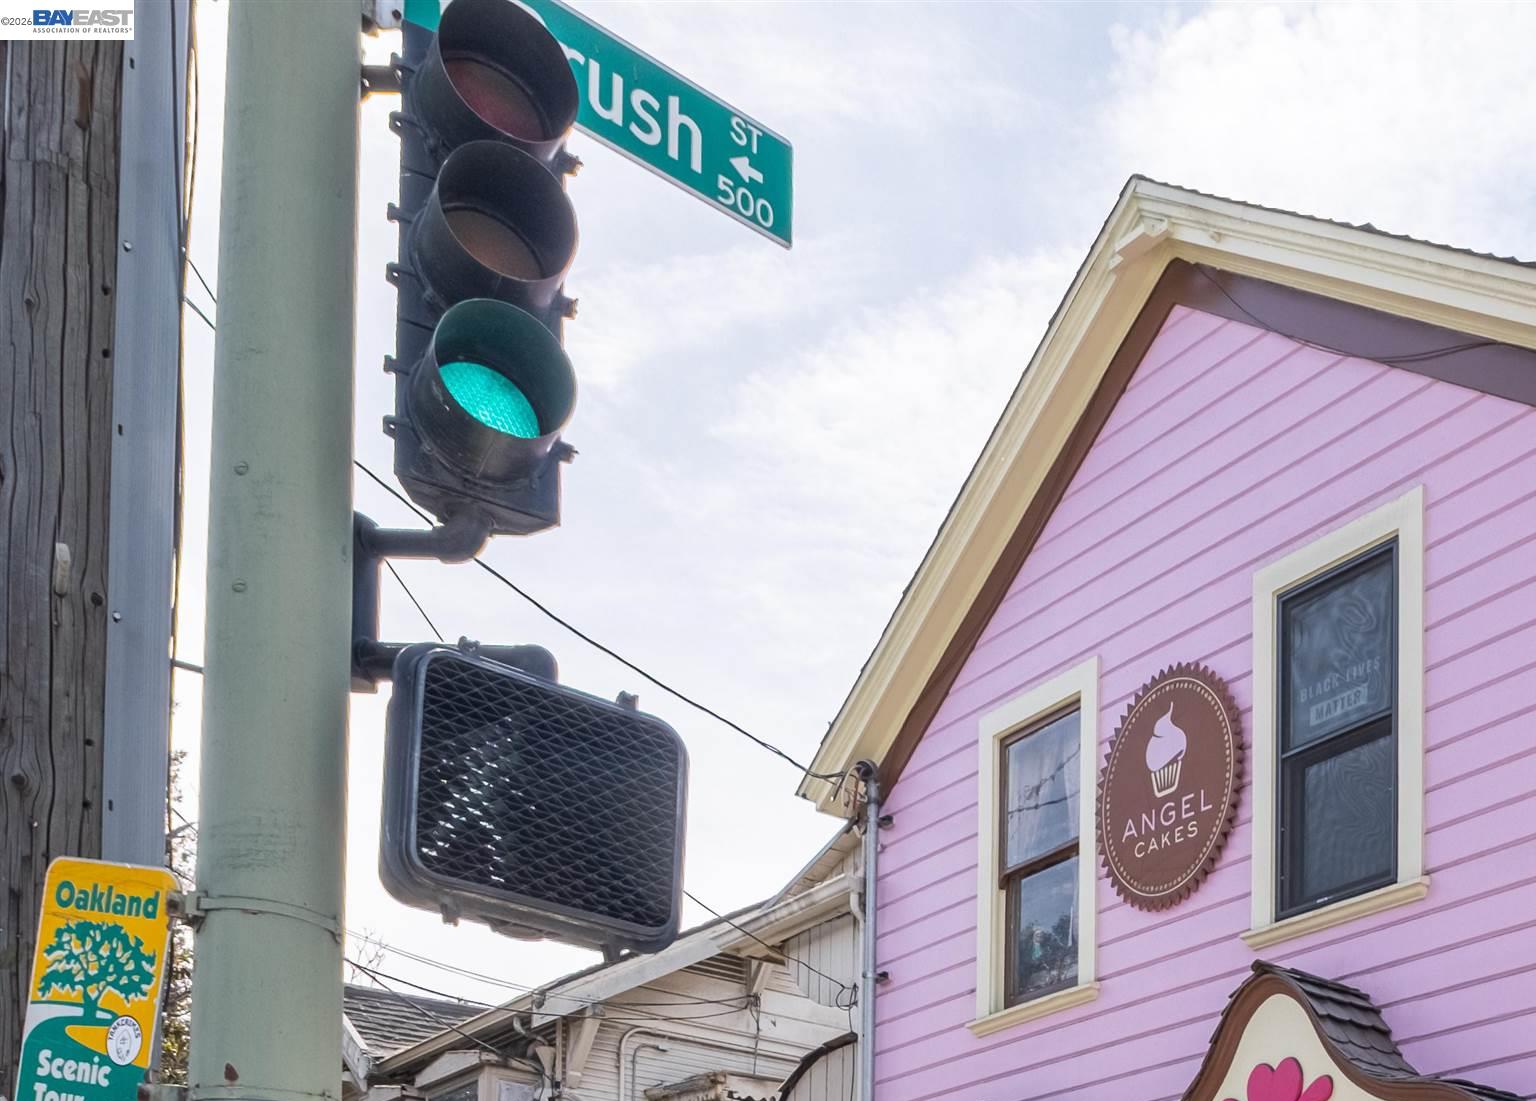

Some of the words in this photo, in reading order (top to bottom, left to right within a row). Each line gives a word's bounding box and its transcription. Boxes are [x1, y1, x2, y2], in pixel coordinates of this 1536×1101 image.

[535, 14, 702, 175] rush
[729, 115, 764, 155] ST
[717, 174, 774, 228] 500
[1300, 673, 1340, 702] BLACK
[1345, 655, 1380, 682] LIVES
[1121, 788, 1213, 843] ANGEL
[1134, 820, 1199, 859] CAKES
[55, 880, 160, 919] Oakland
[36, 1049, 111, 1088] Scenic
